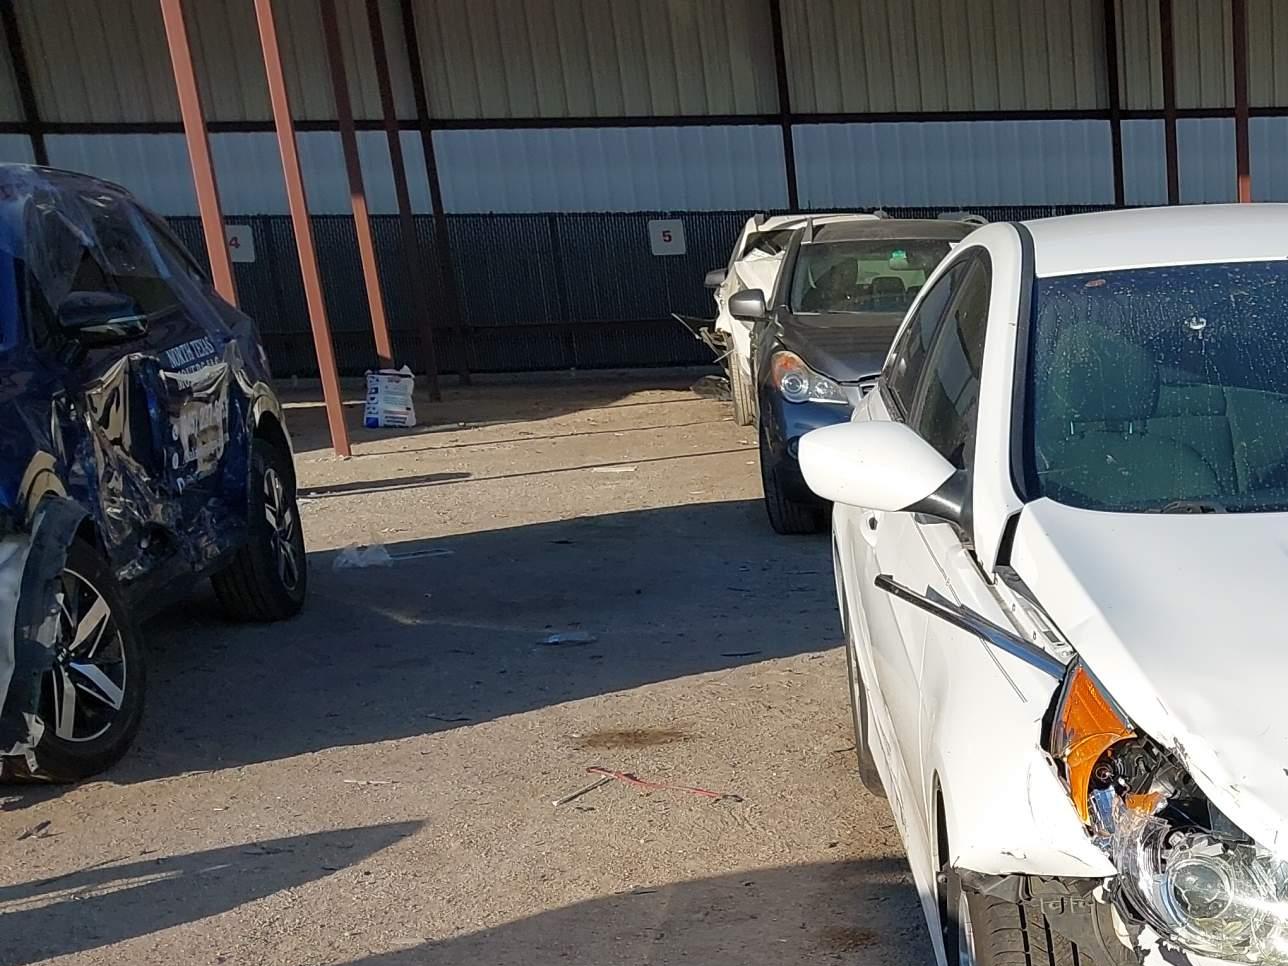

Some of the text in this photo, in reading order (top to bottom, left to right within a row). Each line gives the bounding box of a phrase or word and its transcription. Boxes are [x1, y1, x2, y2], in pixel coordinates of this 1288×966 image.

[662, 230, 672, 242] 5
[229, 237, 240, 249] 4
[166, 336, 216, 368] NORTH TEXAS
